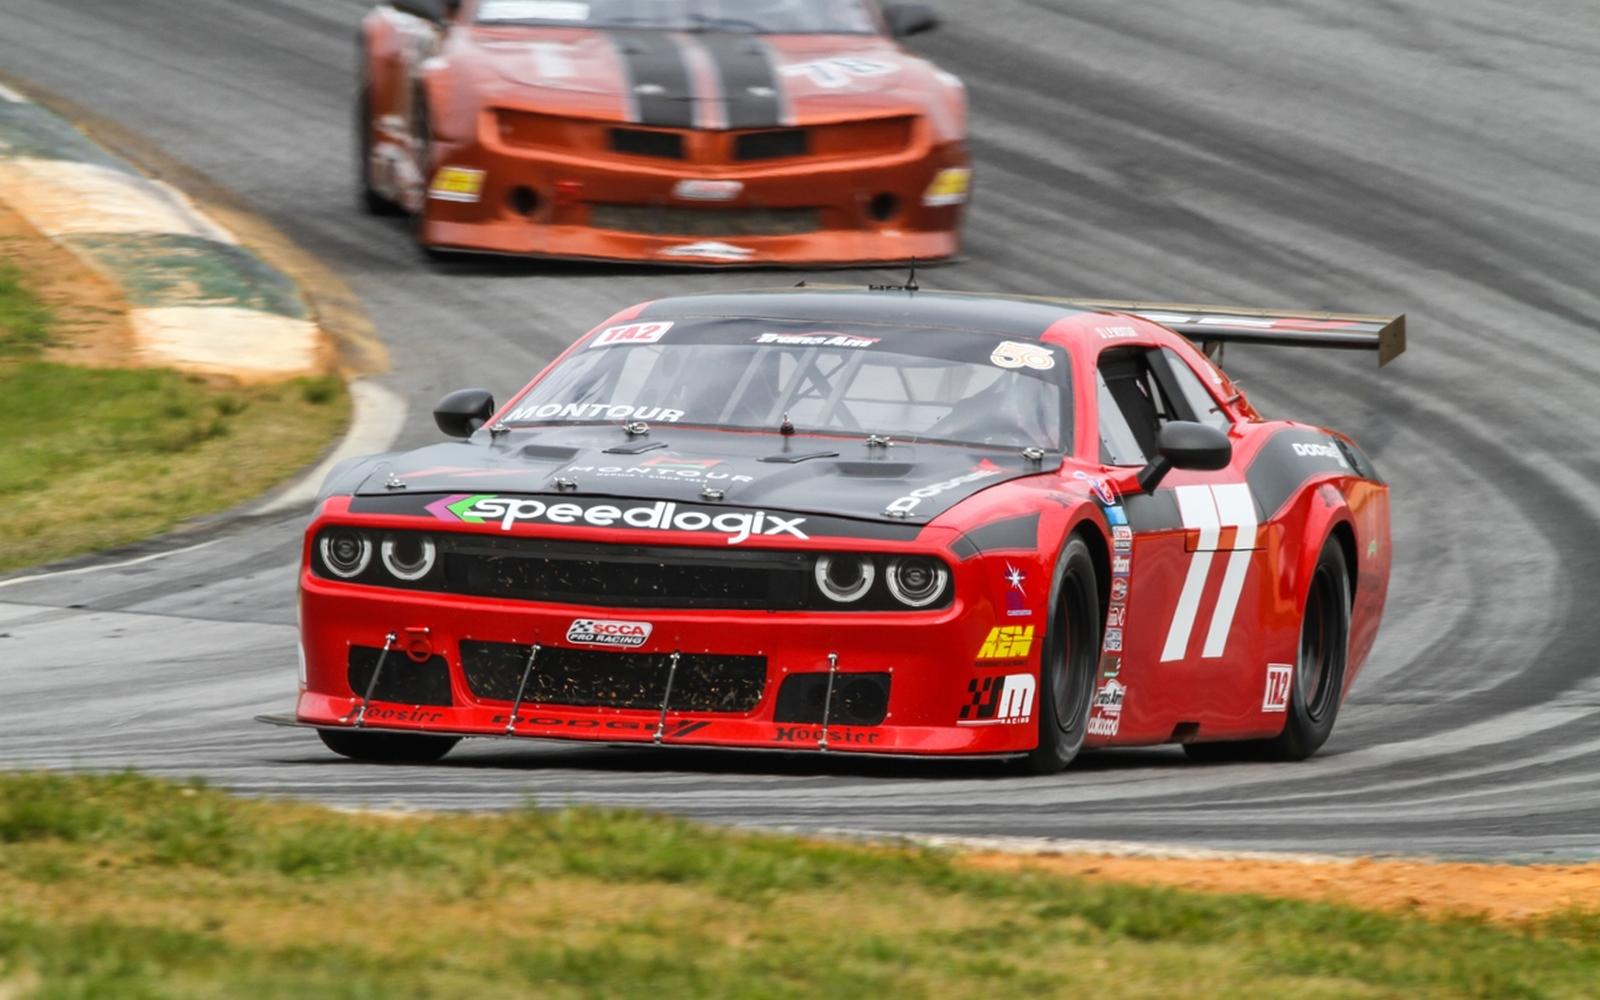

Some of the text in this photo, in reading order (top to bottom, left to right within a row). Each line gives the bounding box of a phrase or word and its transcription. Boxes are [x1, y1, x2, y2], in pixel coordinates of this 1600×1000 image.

[603, 324, 663, 342] TA2
[757, 333, 874, 347] Trans Am
[506, 403, 686, 423] MONTOUR
[567, 465, 754, 483] MONTOUR
[464, 498, 810, 545] speedlogix
[569, 633, 643, 644] PRO RACING
[593, 624, 645, 636] SCCA
[976, 624, 1035, 659] AEM
